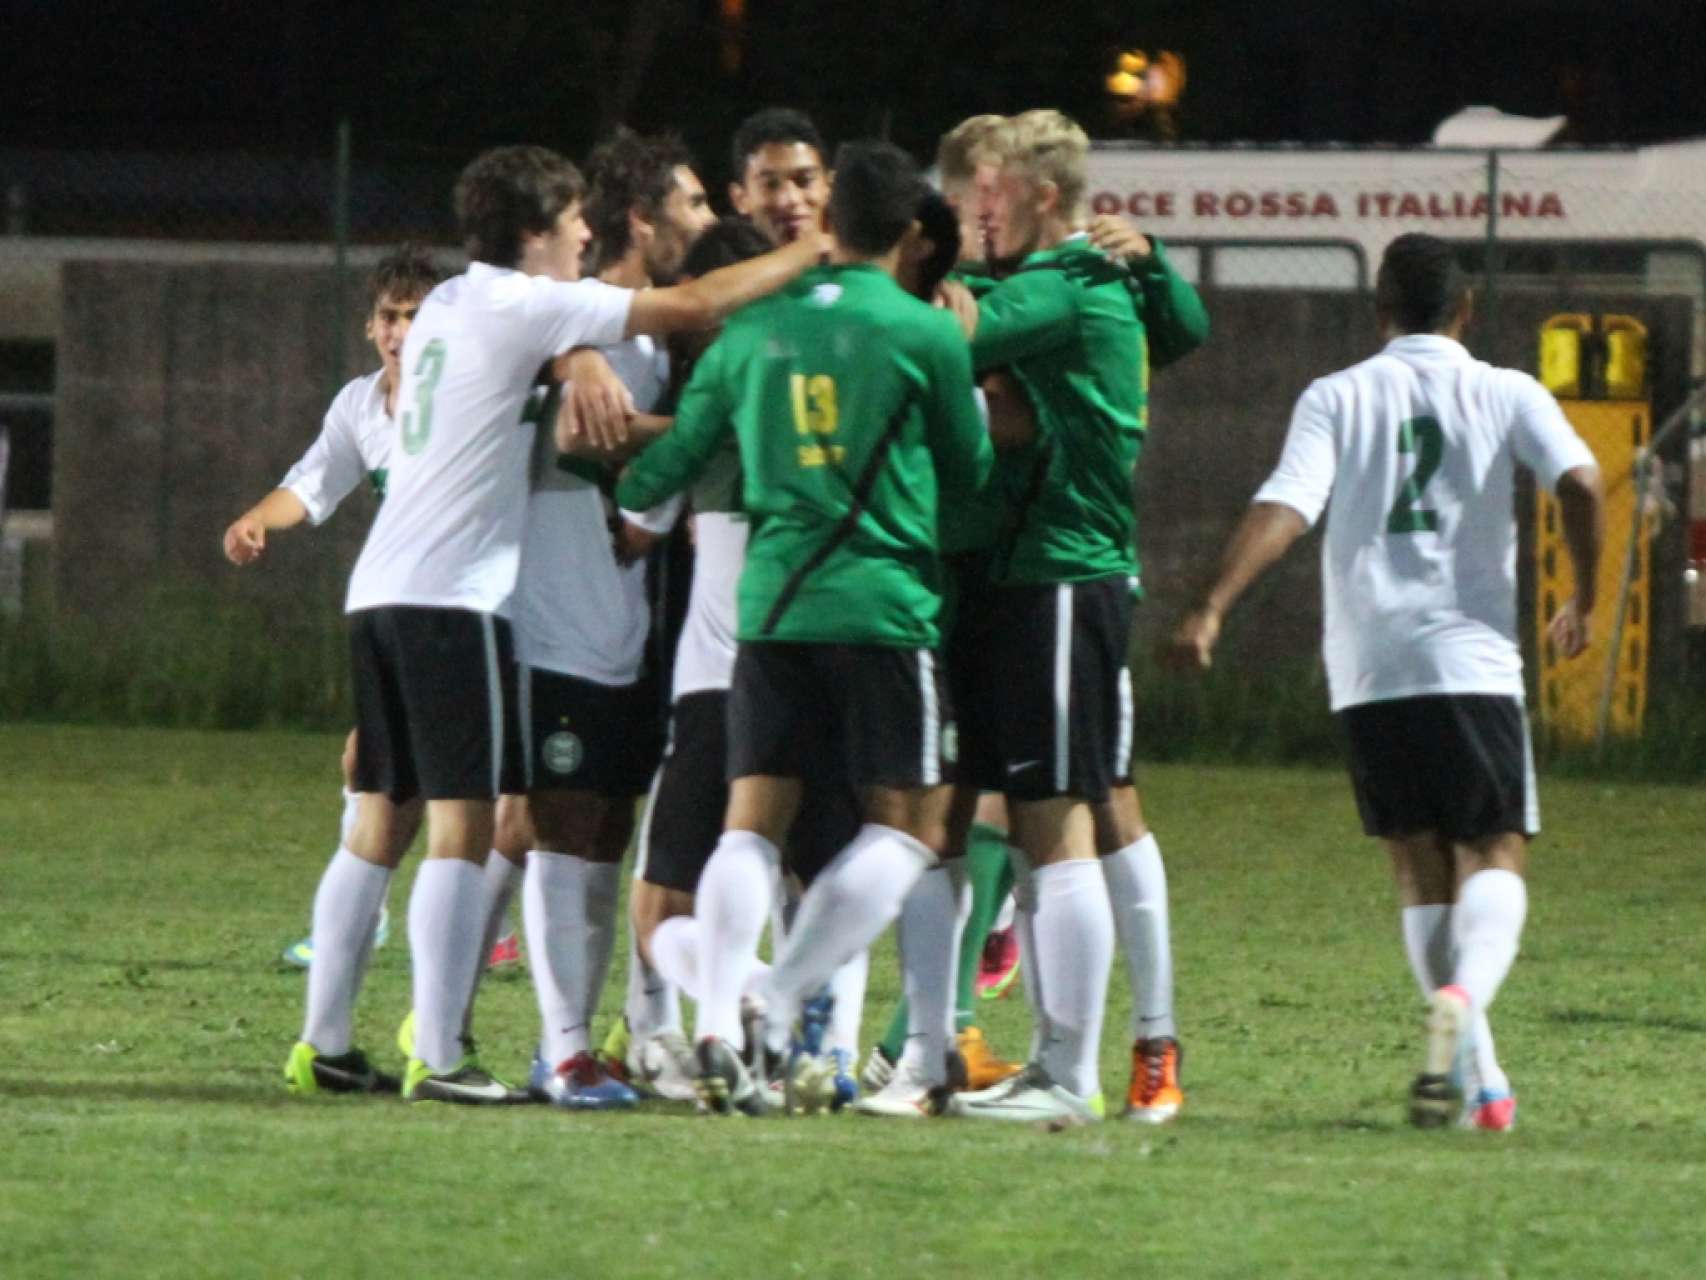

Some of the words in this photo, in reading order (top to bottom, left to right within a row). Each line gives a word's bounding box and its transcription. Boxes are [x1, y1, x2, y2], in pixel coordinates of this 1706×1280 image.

[1092, 191, 1176, 217] OCE
[1193, 191, 1339, 217] ROSSA
[1357, 191, 1567, 217] ITALIANA
[402, 337, 448, 456] 3
[790, 374, 838, 434] 13
[1387, 415, 1444, 534] 2
